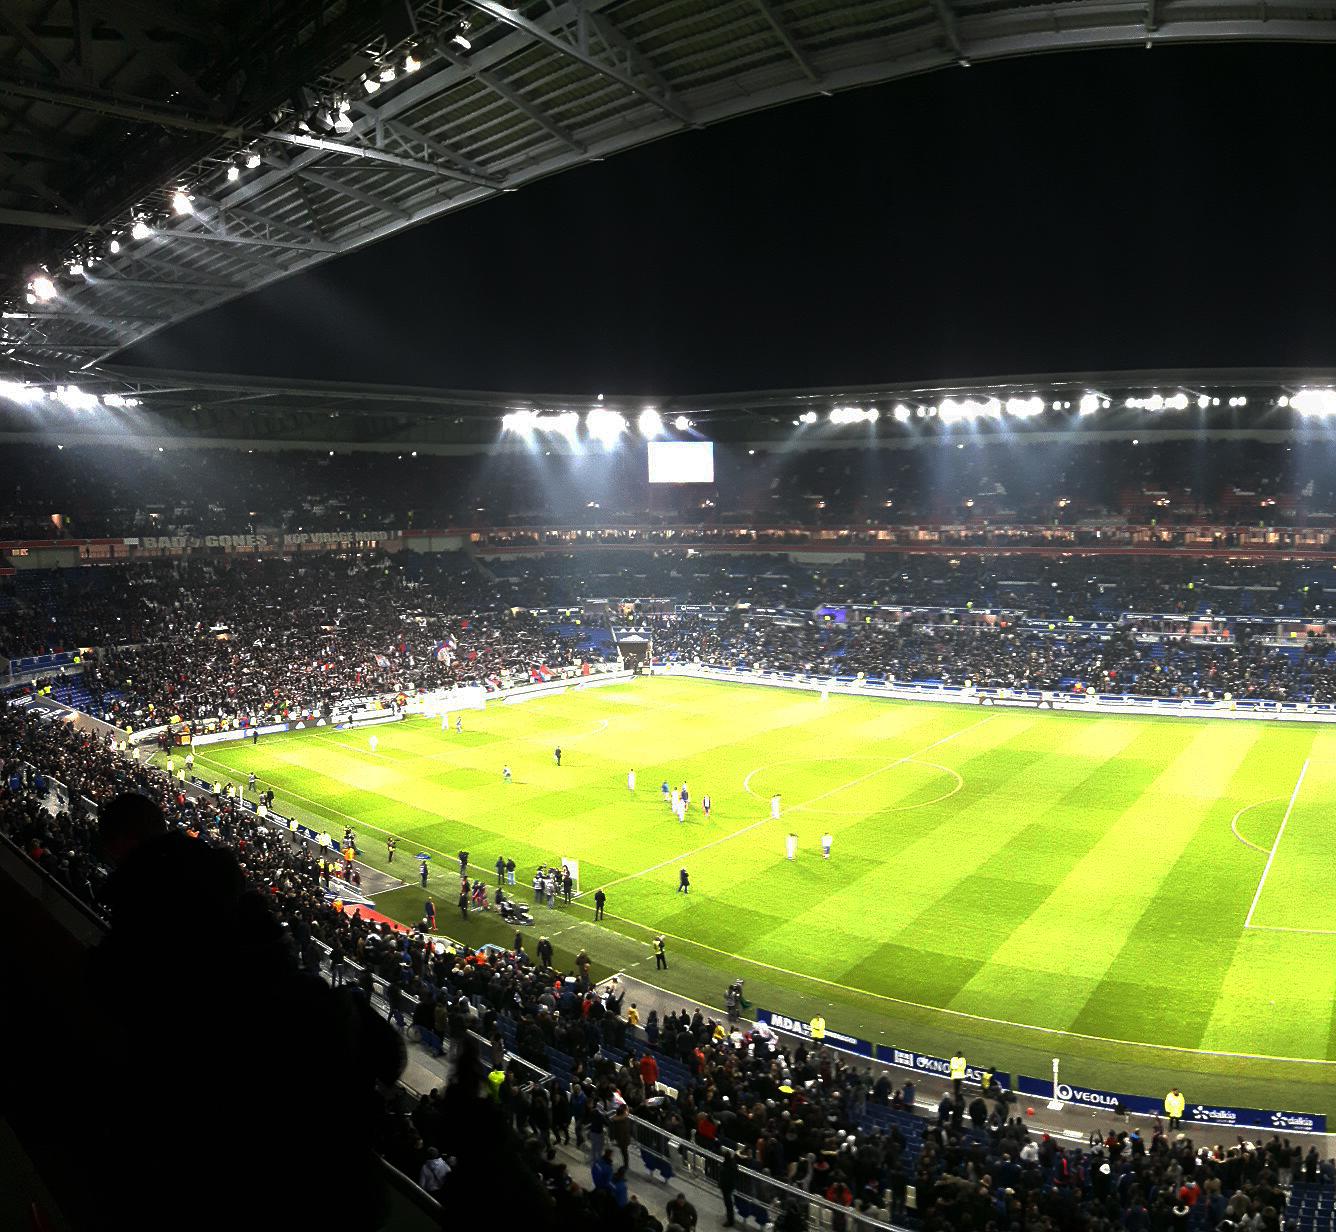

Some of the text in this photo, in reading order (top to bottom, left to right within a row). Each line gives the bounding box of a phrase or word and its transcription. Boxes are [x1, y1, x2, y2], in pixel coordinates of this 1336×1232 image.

[204, 534, 268, 547] GONES
[771, 1013, 802, 1034] MDA
[916, 1056, 989, 1081] OKNOAS
[1073, 1090, 1119, 1106] VEOLIA
